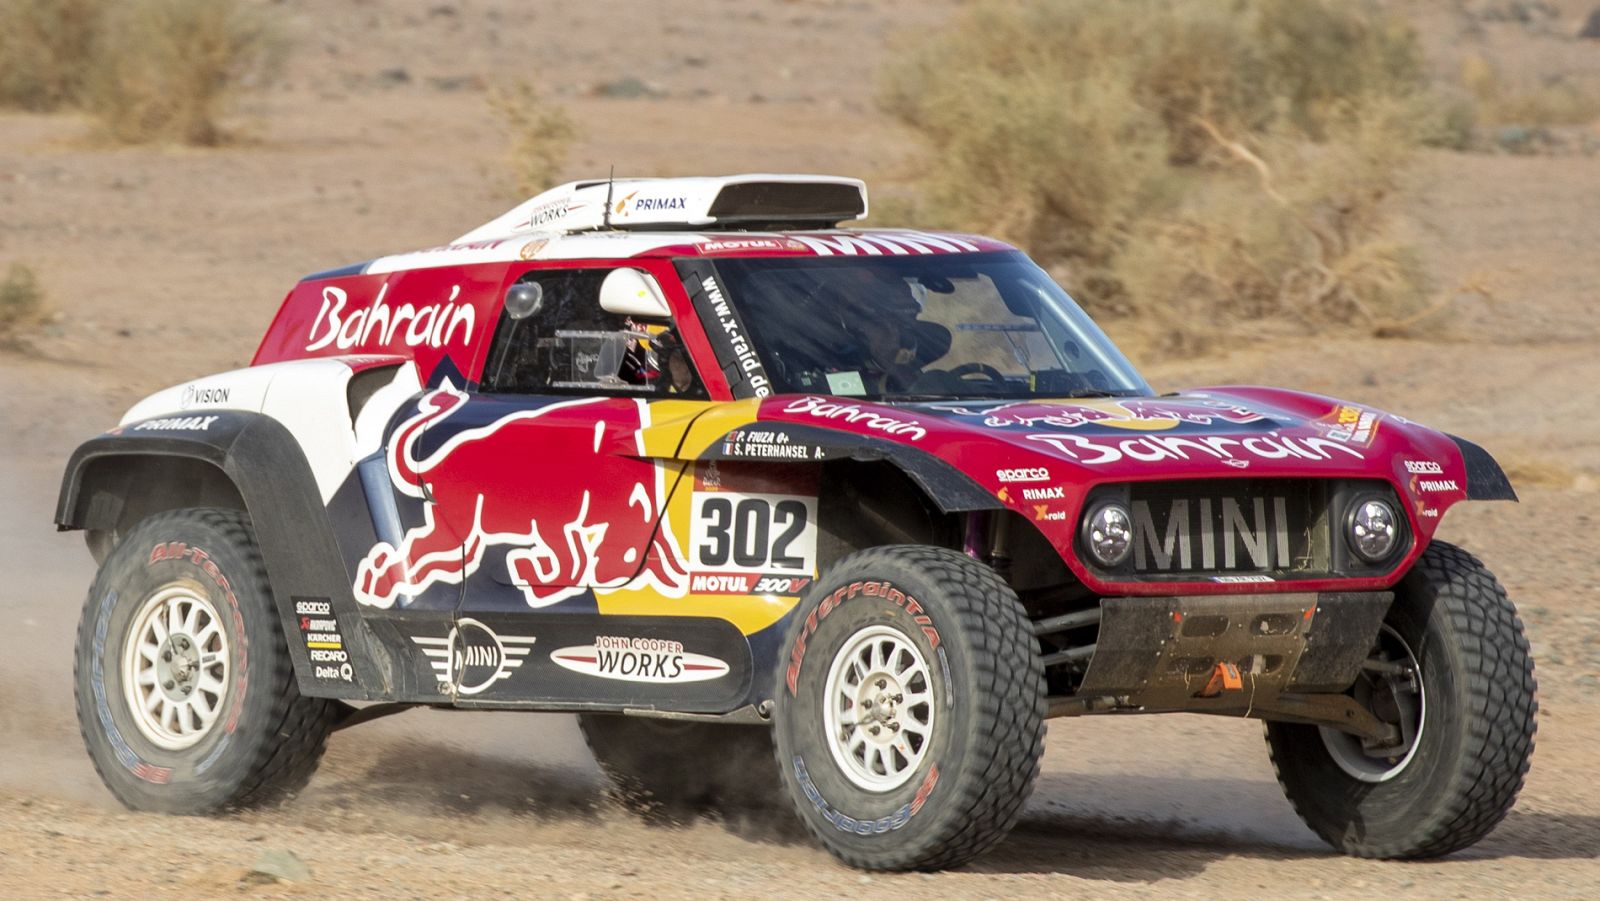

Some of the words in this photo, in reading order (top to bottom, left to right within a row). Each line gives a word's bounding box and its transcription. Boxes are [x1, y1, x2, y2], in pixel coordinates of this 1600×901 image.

[635, 198, 687, 210] PRIMAX
[704, 240, 776, 251] MOTUL
[305, 283, 475, 351] Bahrain
[701, 276, 769, 398] www.x-raid.de
[195, 388, 230, 403] VISION
[783, 396, 926, 441] Bahrain
[747, 431, 774, 443] FIUZA
[734, 443, 743, 456] S.
[745, 443, 808, 459] PETERHANSEL
[1026, 431, 1365, 464] Bahrain
[996, 467, 1050, 482] sparco
[1419, 480, 1459, 492] PRIMAX
[699, 497, 808, 570] 302
[1131, 497, 1291, 570] MINI
[692, 576, 748, 592] MOTUL
[754, 578, 810, 593] 300V
[296, 601, 330, 615] sparco
[596, 637, 628, 649] JOHN
[633, 639, 682, 654] COOPER
[311, 650, 347, 662] RECARO
[454, 645, 498, 670] MINI
[598, 650, 683, 678] WORKS
